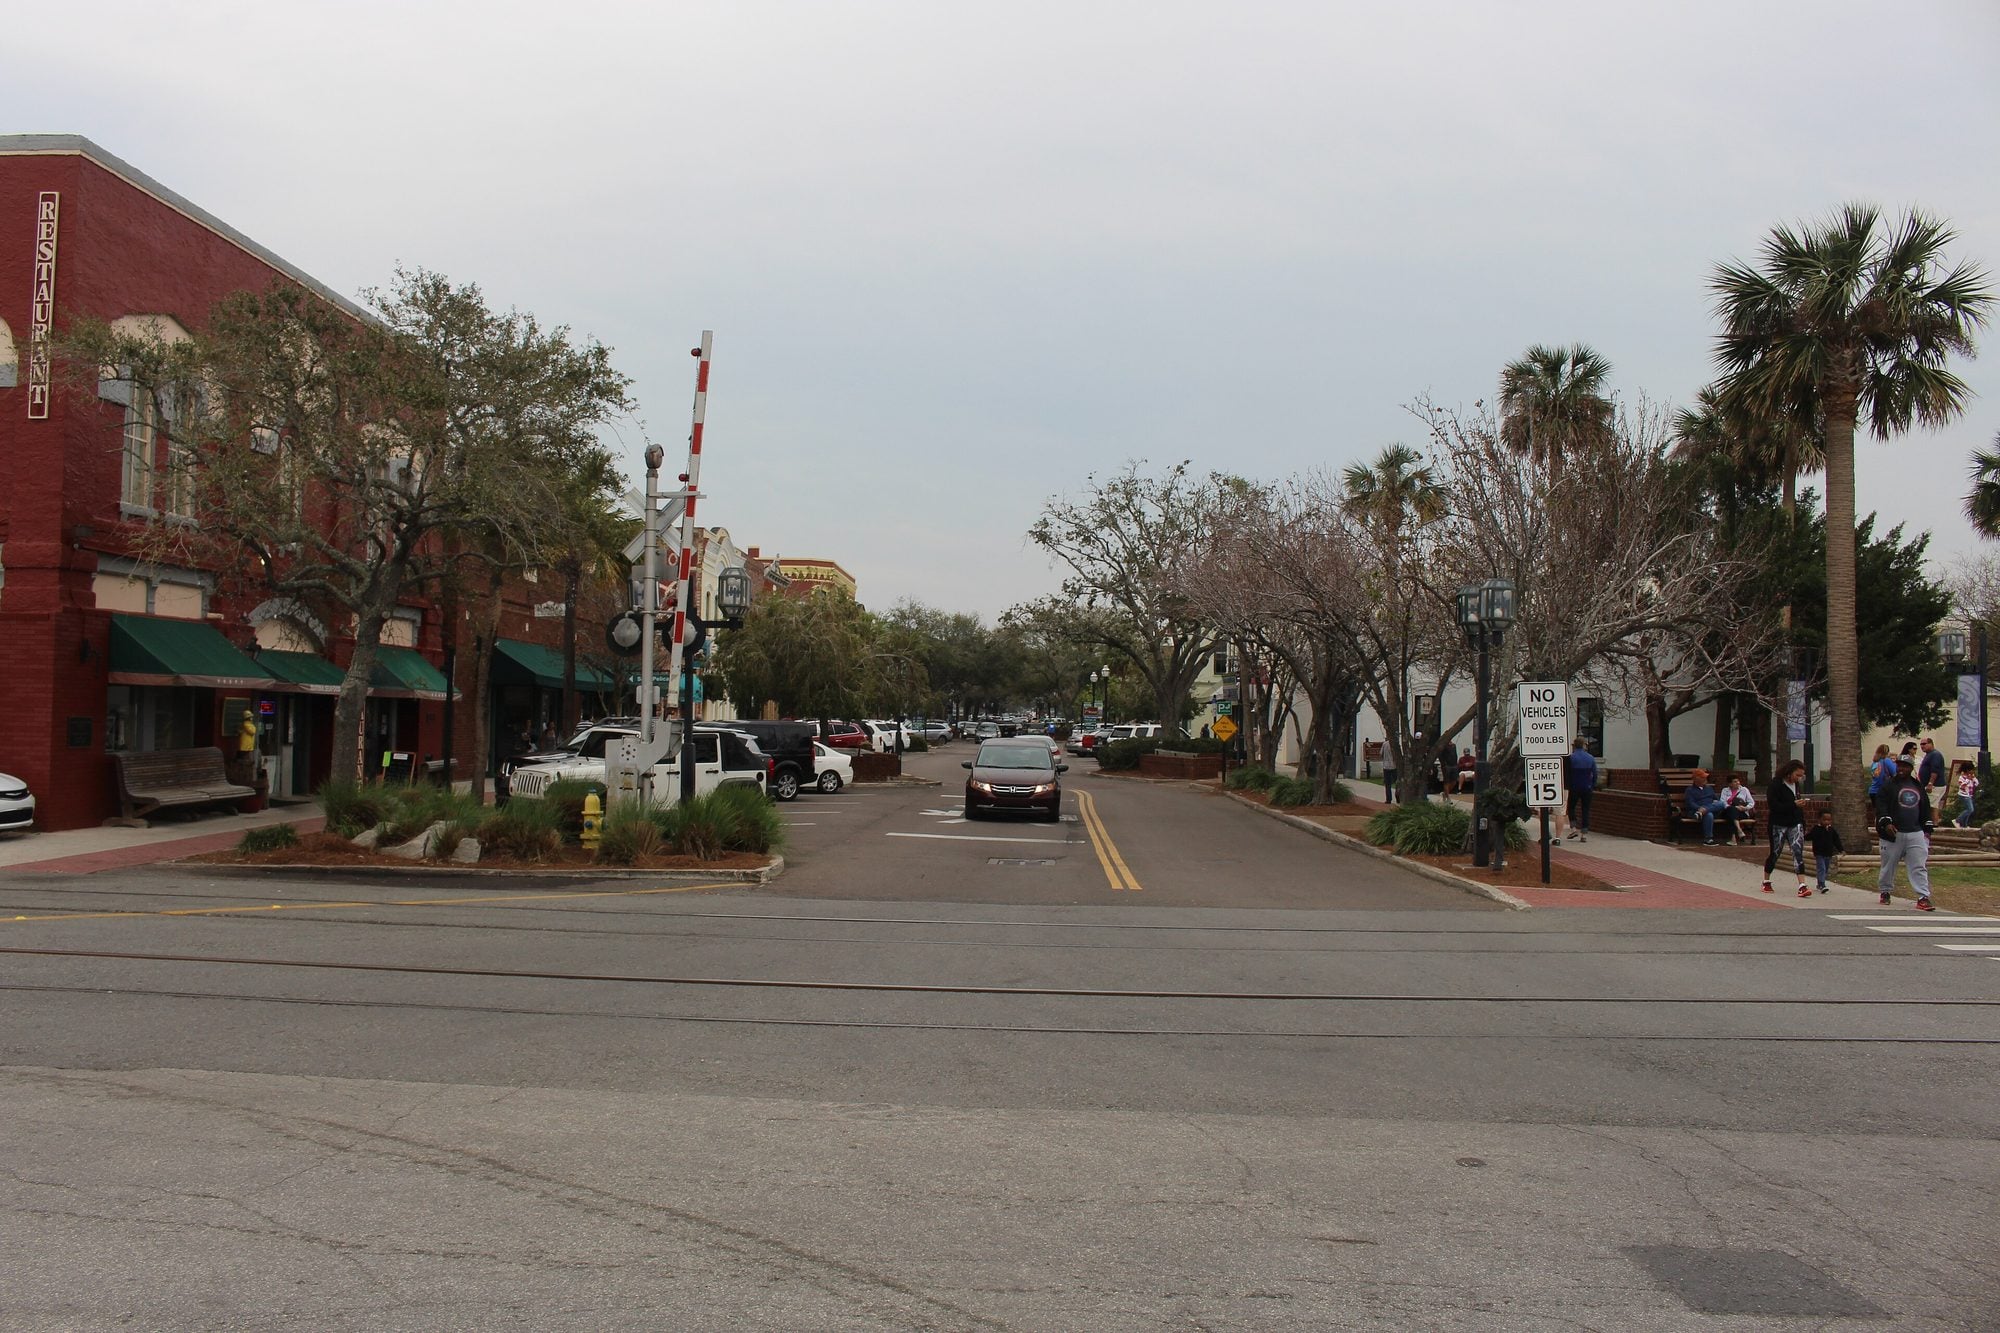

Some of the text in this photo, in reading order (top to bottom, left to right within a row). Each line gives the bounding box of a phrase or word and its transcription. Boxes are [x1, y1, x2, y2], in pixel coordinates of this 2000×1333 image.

[1530, 689, 1555, 702] NO
[1521, 706, 1566, 718] VEHICLES
[1531, 722, 1556, 730] OVER
[1525, 736, 1564, 744] 7000 LBS
[1529, 762, 1560, 770] SPEED
[1533, 783, 1557, 801] 15
